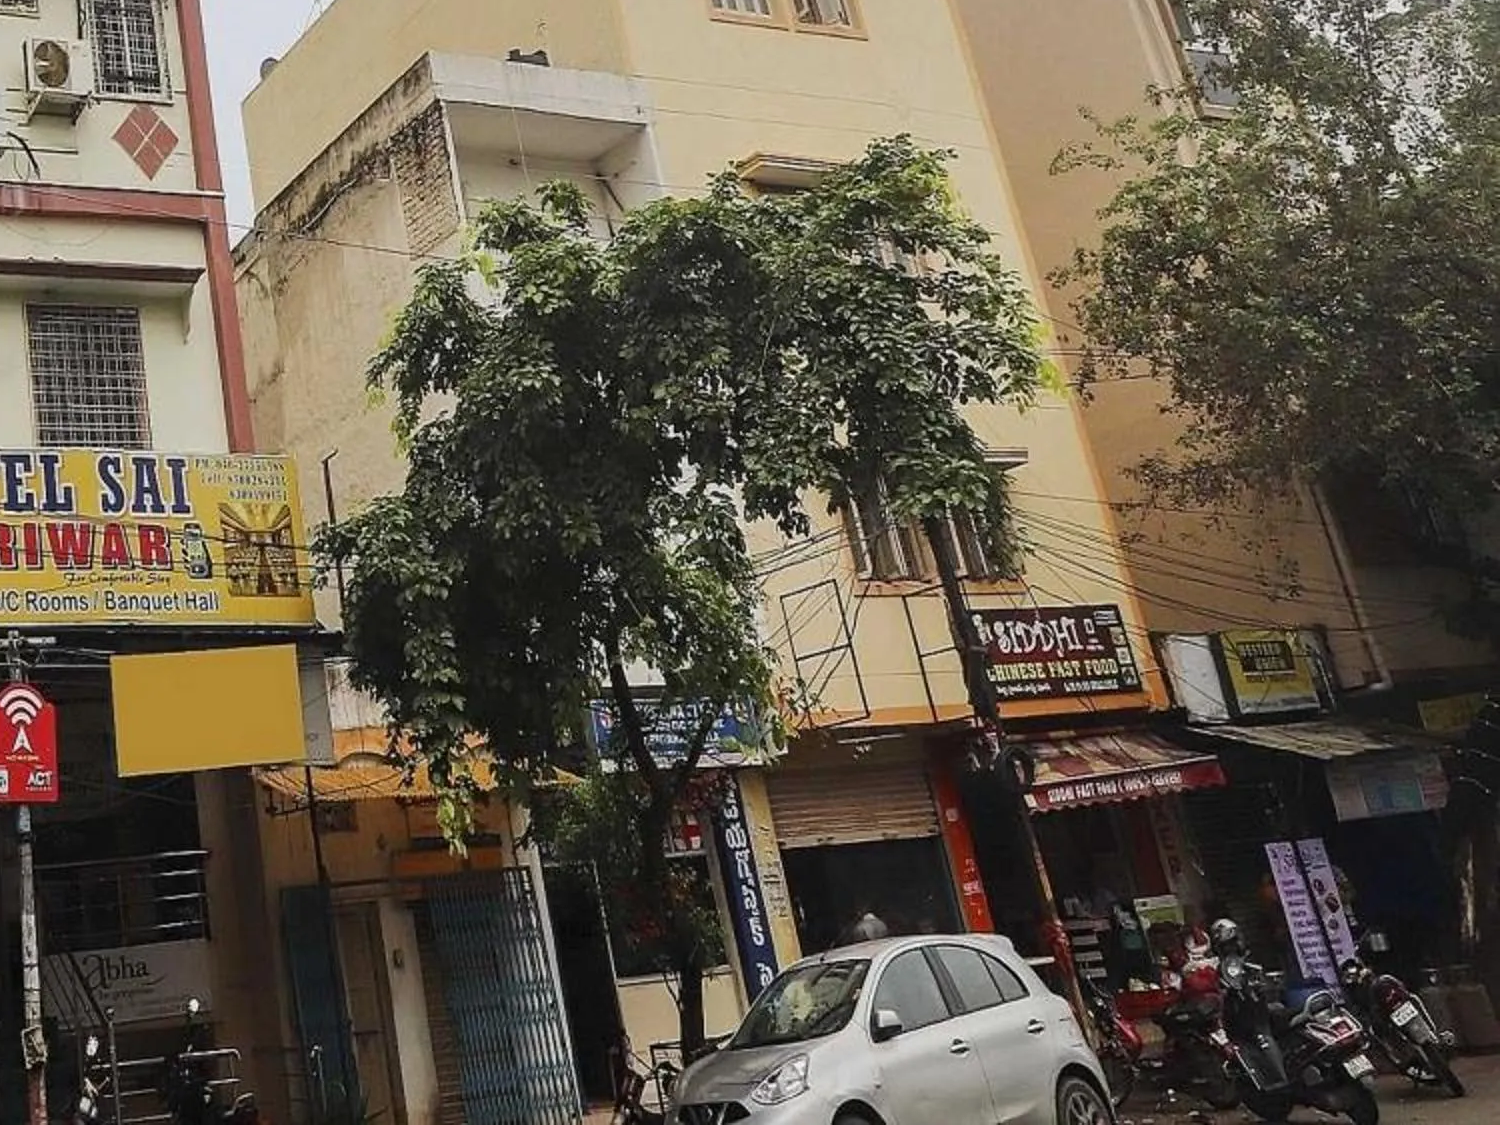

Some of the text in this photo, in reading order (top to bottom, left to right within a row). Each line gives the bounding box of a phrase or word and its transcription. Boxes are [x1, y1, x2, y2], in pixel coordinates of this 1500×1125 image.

[97, 454, 192, 515] SAI
[24, 590, 89, 612] Rooms
[103, 590, 181, 615] Banquet
[185, 591, 220, 612] Hall
[993, 617, 1084, 657] SIDDHI
[986, 658, 1119, 682] CHINESE FAST FOOD
[27, 770, 52, 787] ACT
